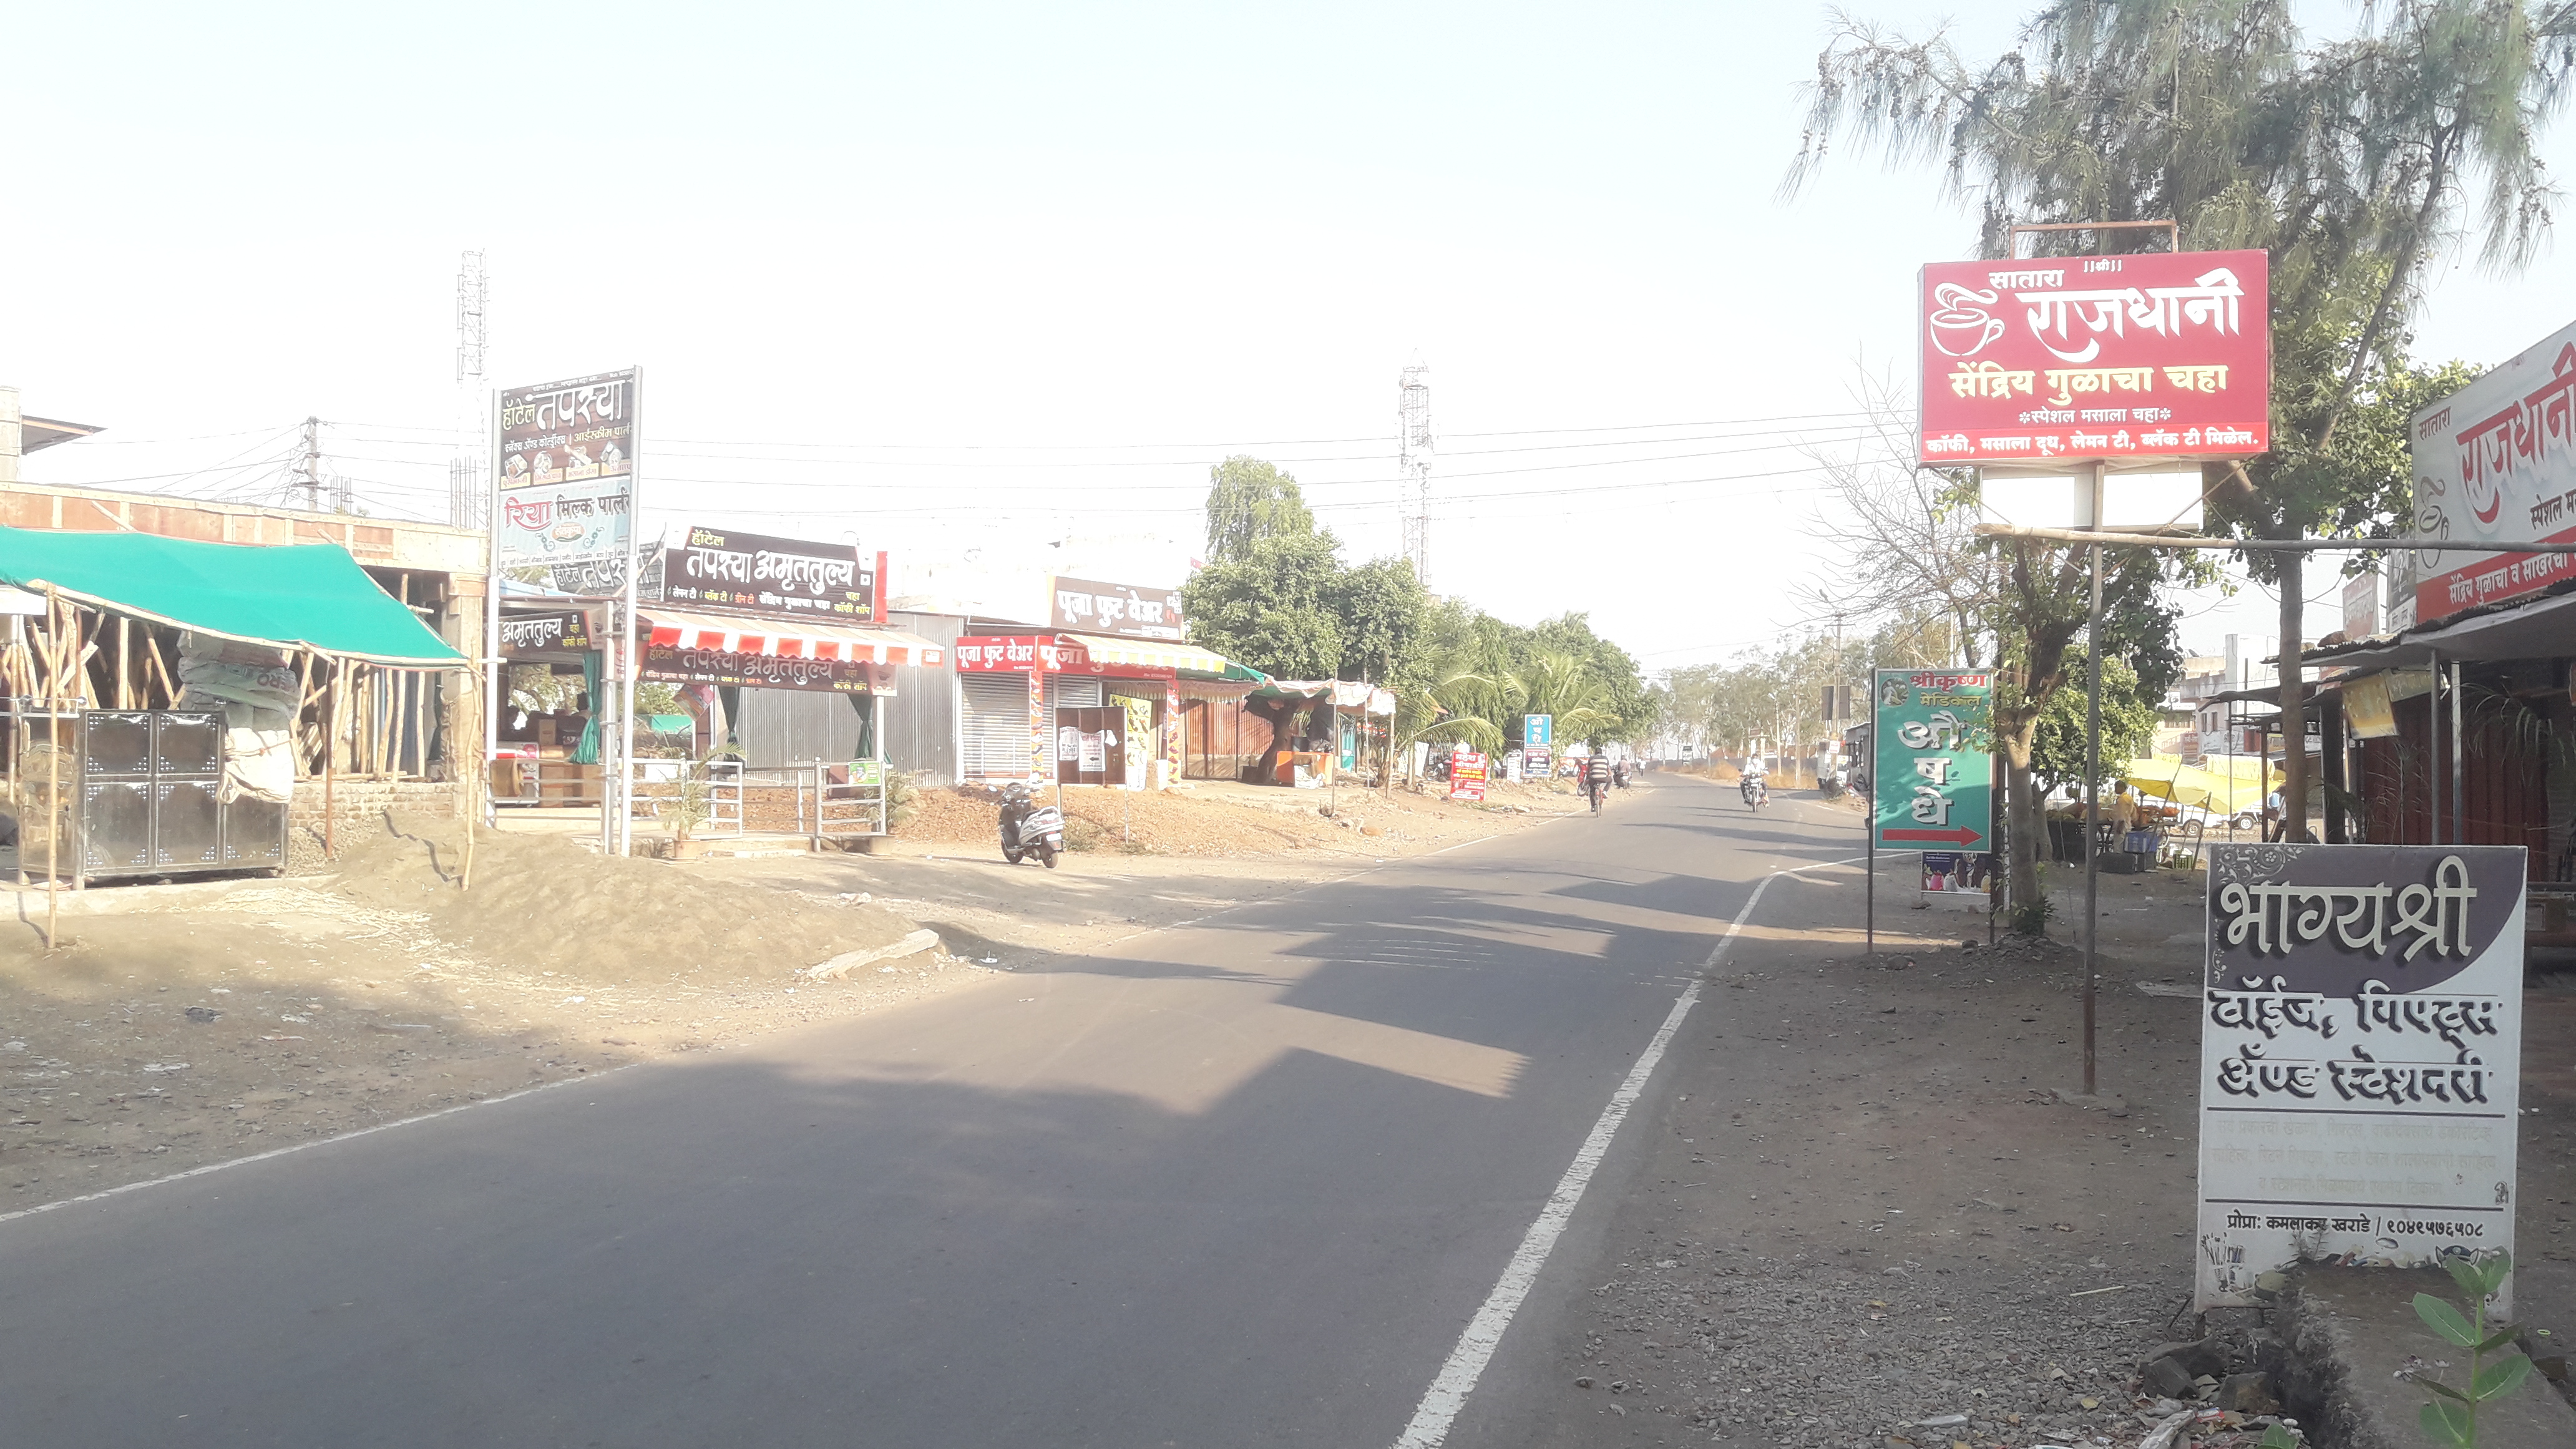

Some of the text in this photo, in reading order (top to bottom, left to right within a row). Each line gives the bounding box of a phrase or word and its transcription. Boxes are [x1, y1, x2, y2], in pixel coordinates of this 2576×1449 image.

[1989, 270, 2064, 290] सातारा
[2015, 267, 2245, 363] राजधानी
[1949, 361, 2228, 406] सेंद्रिय गुळाचा चहा
[502, 398, 536, 431] हॉटेल
[525, 379, 625, 430] तपस्या
[2030, 407, 2160, 424] स्पेशल मसाला चहा
[2419, 406, 2451, 441] सातारा
[1927, 434, 1975, 454] कॉफी,
[1981, 436, 2030, 452] मसाला
[2071, 433, 2107, 449] लेमन
[2112, 431, 2135, 450] टी,
[2142, 430, 2178, 447] ब्लॅक
[2183, 427, 2201, 446] टी
[2205, 426, 2258, 446] मिळेल.
[504, 496, 553, 531] रिया
[556, 494, 594, 519] मिल्क
[2530, 494, 2562, 530] स्पेशल
[691, 529, 724, 547] हॉटेल
[686, 546, 856, 595] तपस्या अमृततुल्य
[2476, 567, 2508, 606] गुळाचा
[2510, 563, 2519, 584] व
[834, 602, 871, 615] कॉफी शॉप
[846, 591, 860, 601] चहा
[1056, 590, 1163, 628] पूजा फुट वेअर
[502, 618, 563, 647] अमृततुल्य
[649, 646, 835, 685] हॉटेल तपस्या अमृततुल्य
[957, 638, 1033, 668] पूजा फुट वेअर
[1040, 645, 1085, 670] पूजा
[1910, 671, 1988, 693] श्रीकृष्ण
[1920, 692, 1983, 706] मेडिकल
[2220, 855, 2477, 963] भाग्यश्री
[2327, 1044, 2494, 1105] स्टेशनरी
[2331, 1212, 2371, 1232] खराडे
